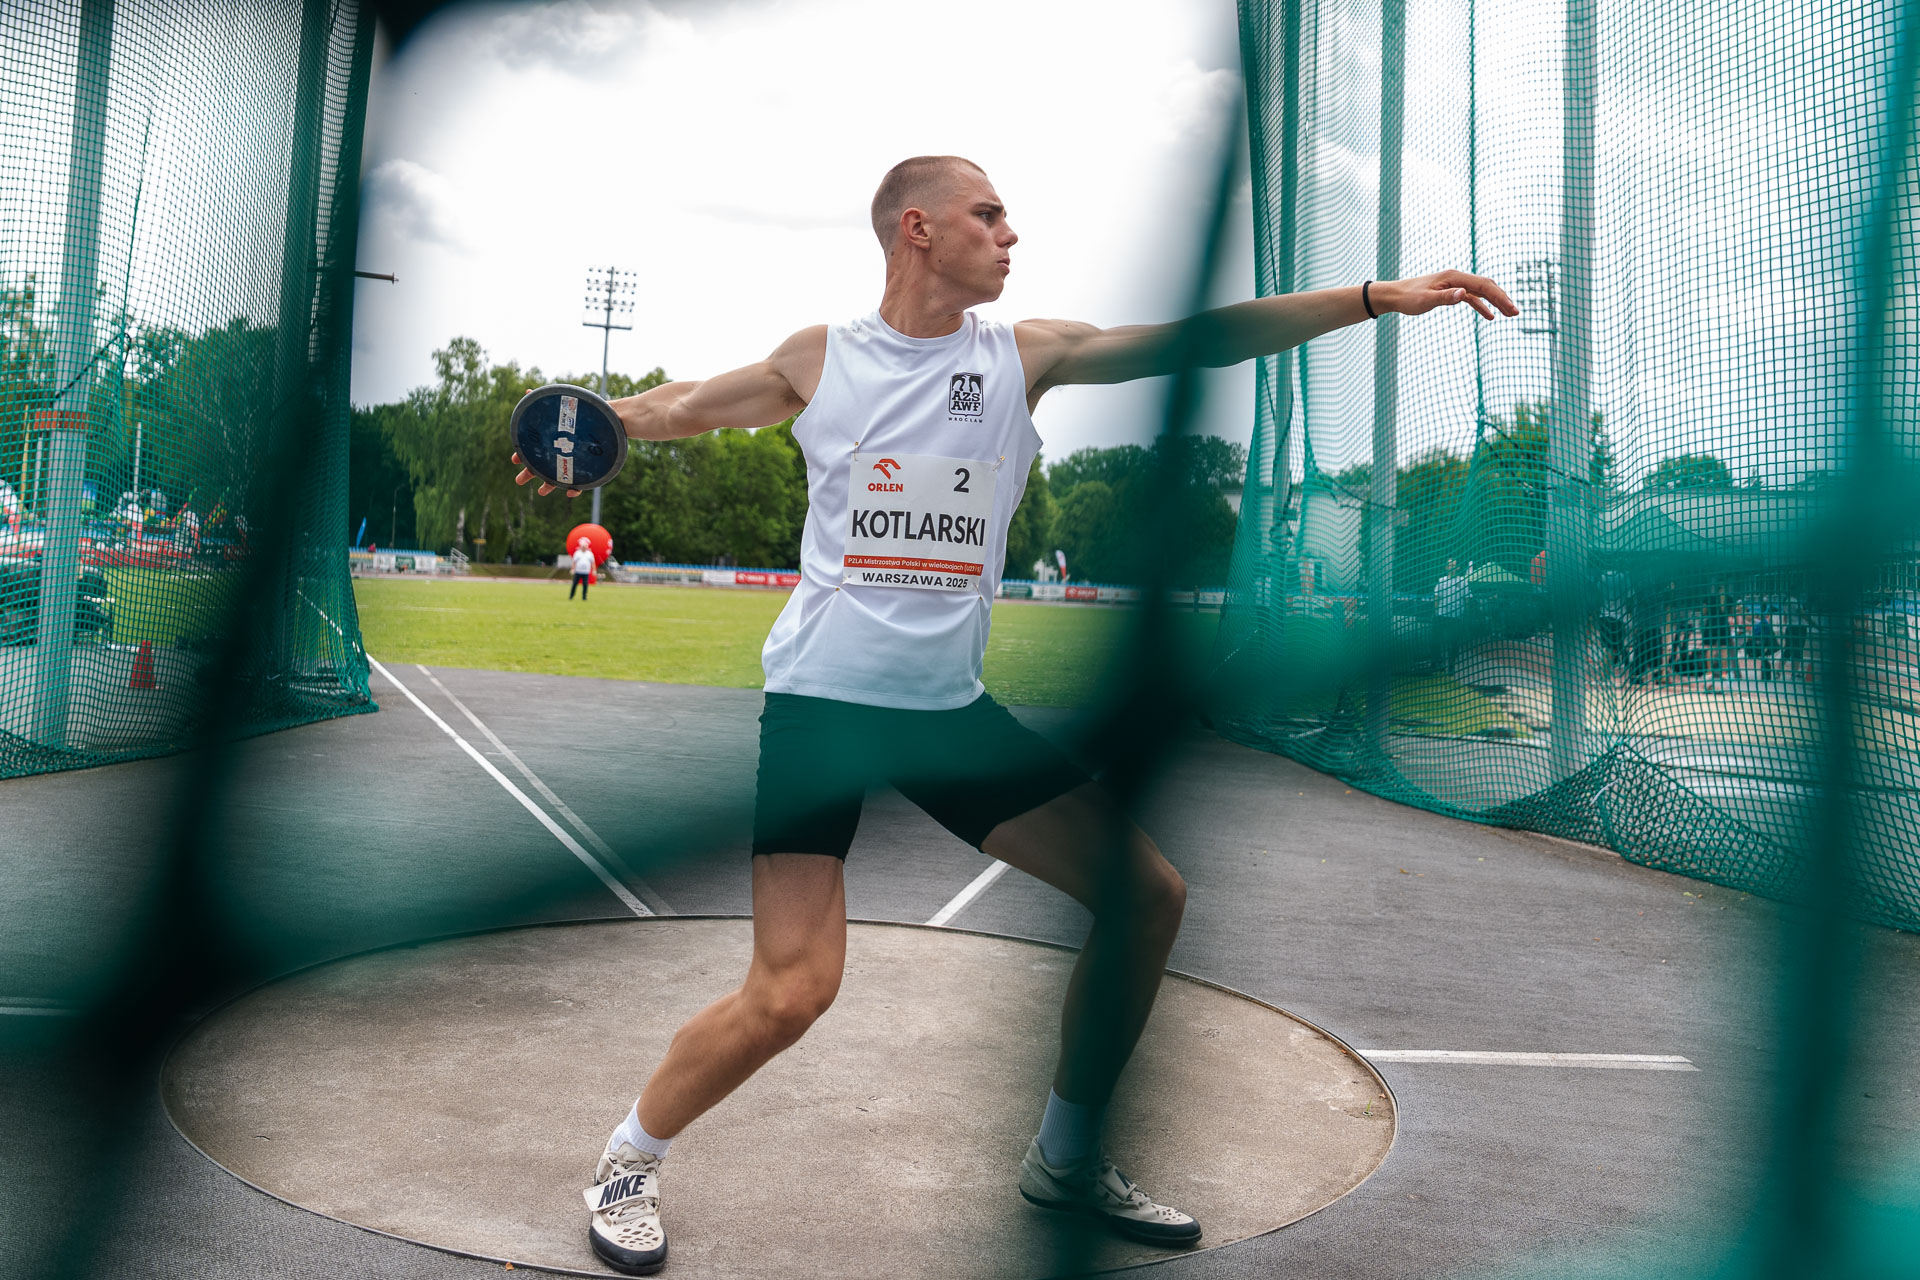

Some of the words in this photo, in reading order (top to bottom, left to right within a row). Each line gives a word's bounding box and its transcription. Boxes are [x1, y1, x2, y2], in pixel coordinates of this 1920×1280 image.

[951, 390, 981, 401] AZS
[951, 401, 981, 411] AWF
[867, 482, 904, 493] ORLEN
[953, 467, 970, 493] 2
[851, 509, 986, 547] KOTLARSKI
[848, 557, 863, 565] PZLA
[864, 559, 901, 567] Mistrzostwa
[929, 561, 964, 571] wielobojach
[862, 572, 943, 587] WARSZAWA
[945, 577, 969, 588] 2025
[598, 1175, 647, 1208] NIKE
